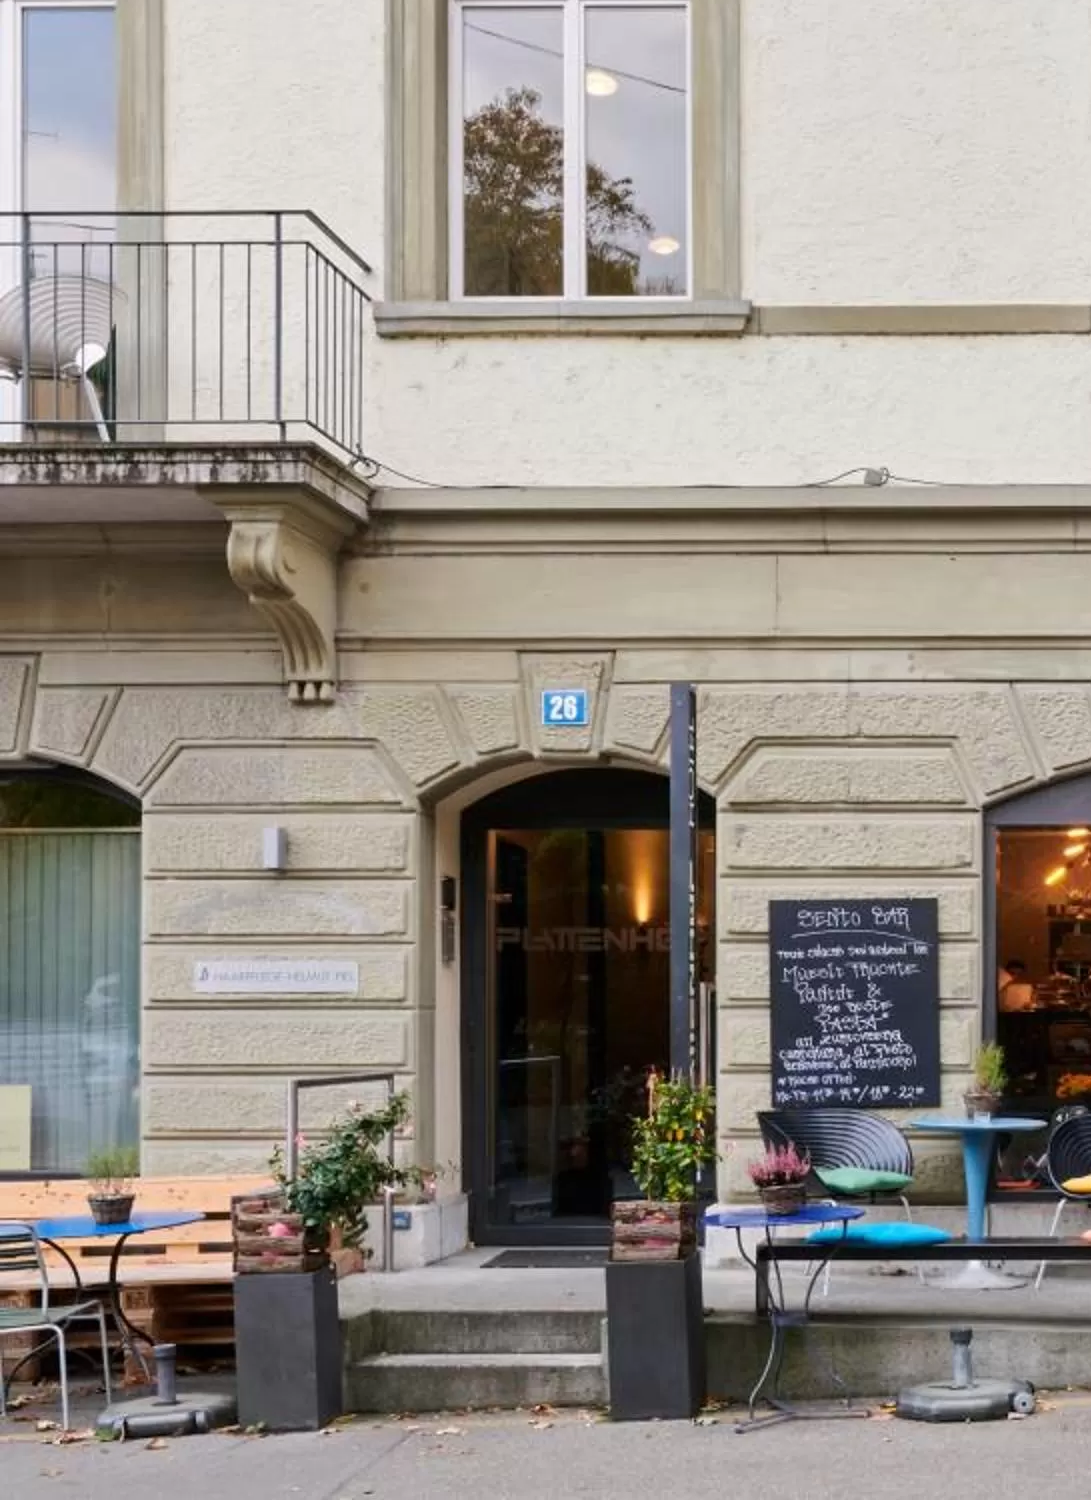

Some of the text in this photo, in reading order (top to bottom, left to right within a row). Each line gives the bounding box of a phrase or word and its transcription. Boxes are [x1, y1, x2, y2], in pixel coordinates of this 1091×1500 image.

[549, 695, 577, 721] 26
[871, 905, 911, 933] BAR
[496, 927, 672, 953] PLATTENHO
